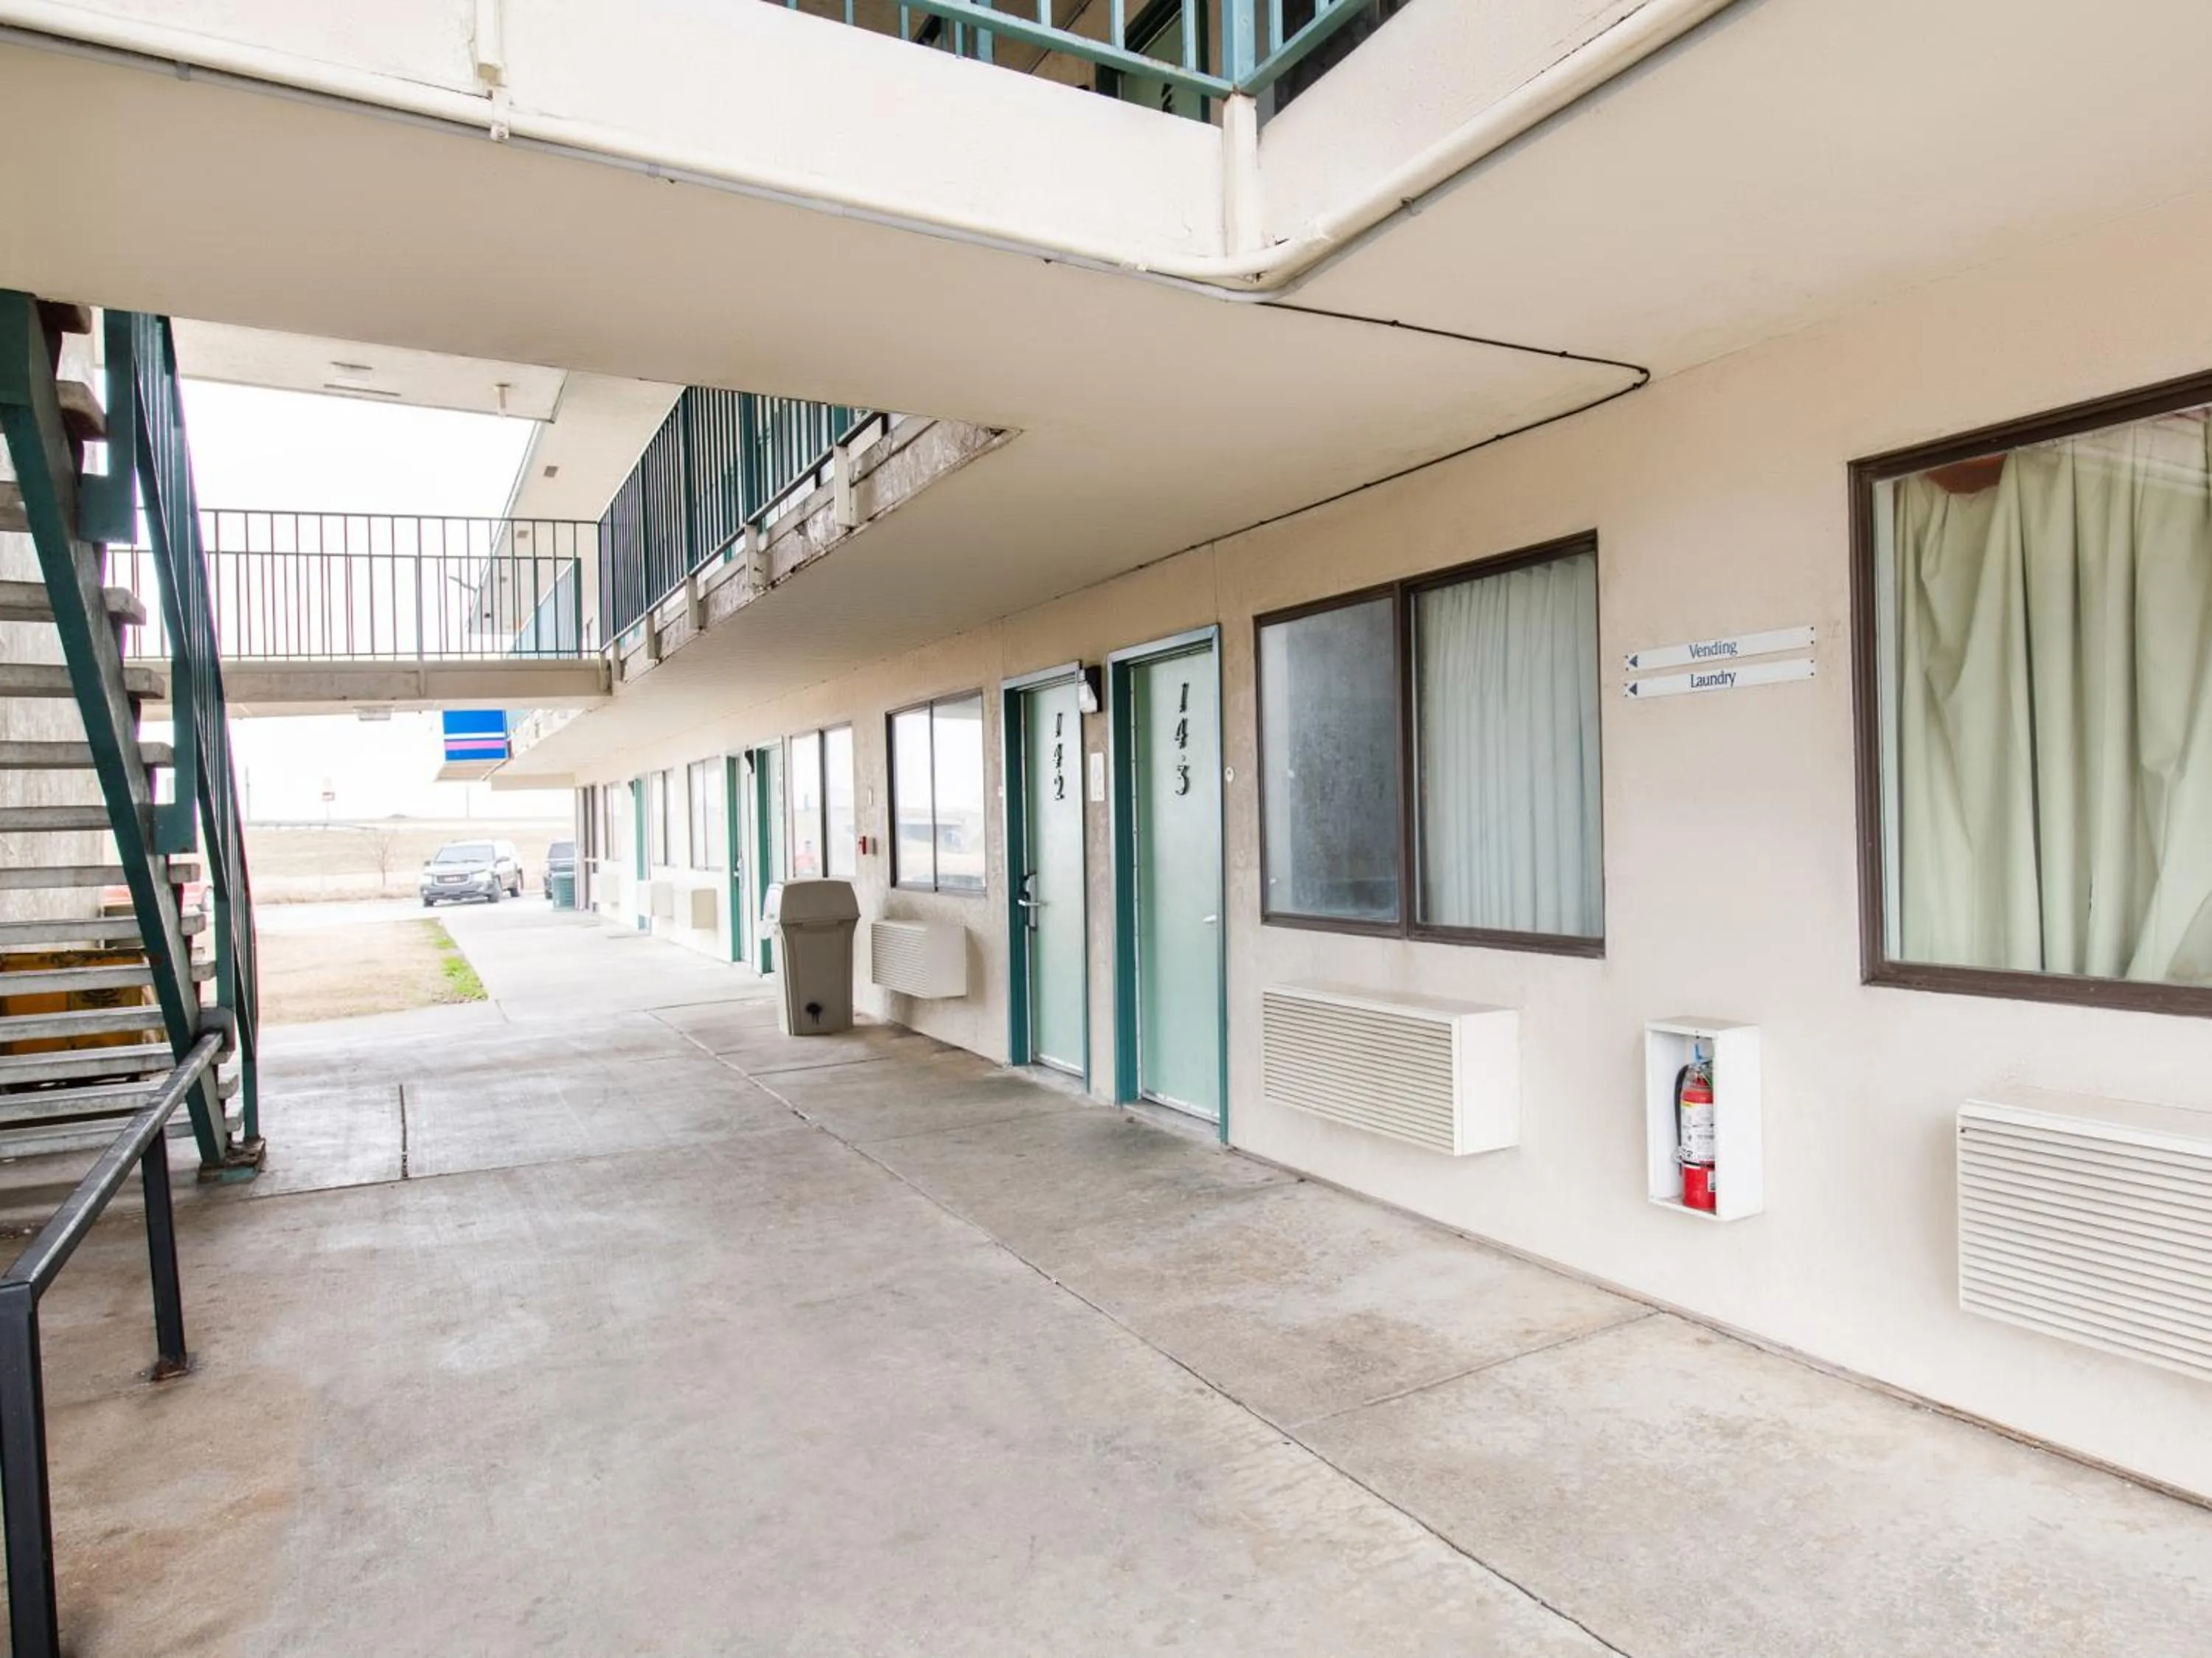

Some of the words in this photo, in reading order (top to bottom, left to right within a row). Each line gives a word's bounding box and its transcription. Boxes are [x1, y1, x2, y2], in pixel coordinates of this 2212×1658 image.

[1689, 641, 1739, 659] Vending
[1690, 670, 1736, 687] Laundry
[1175, 682, 1190, 796] 143
